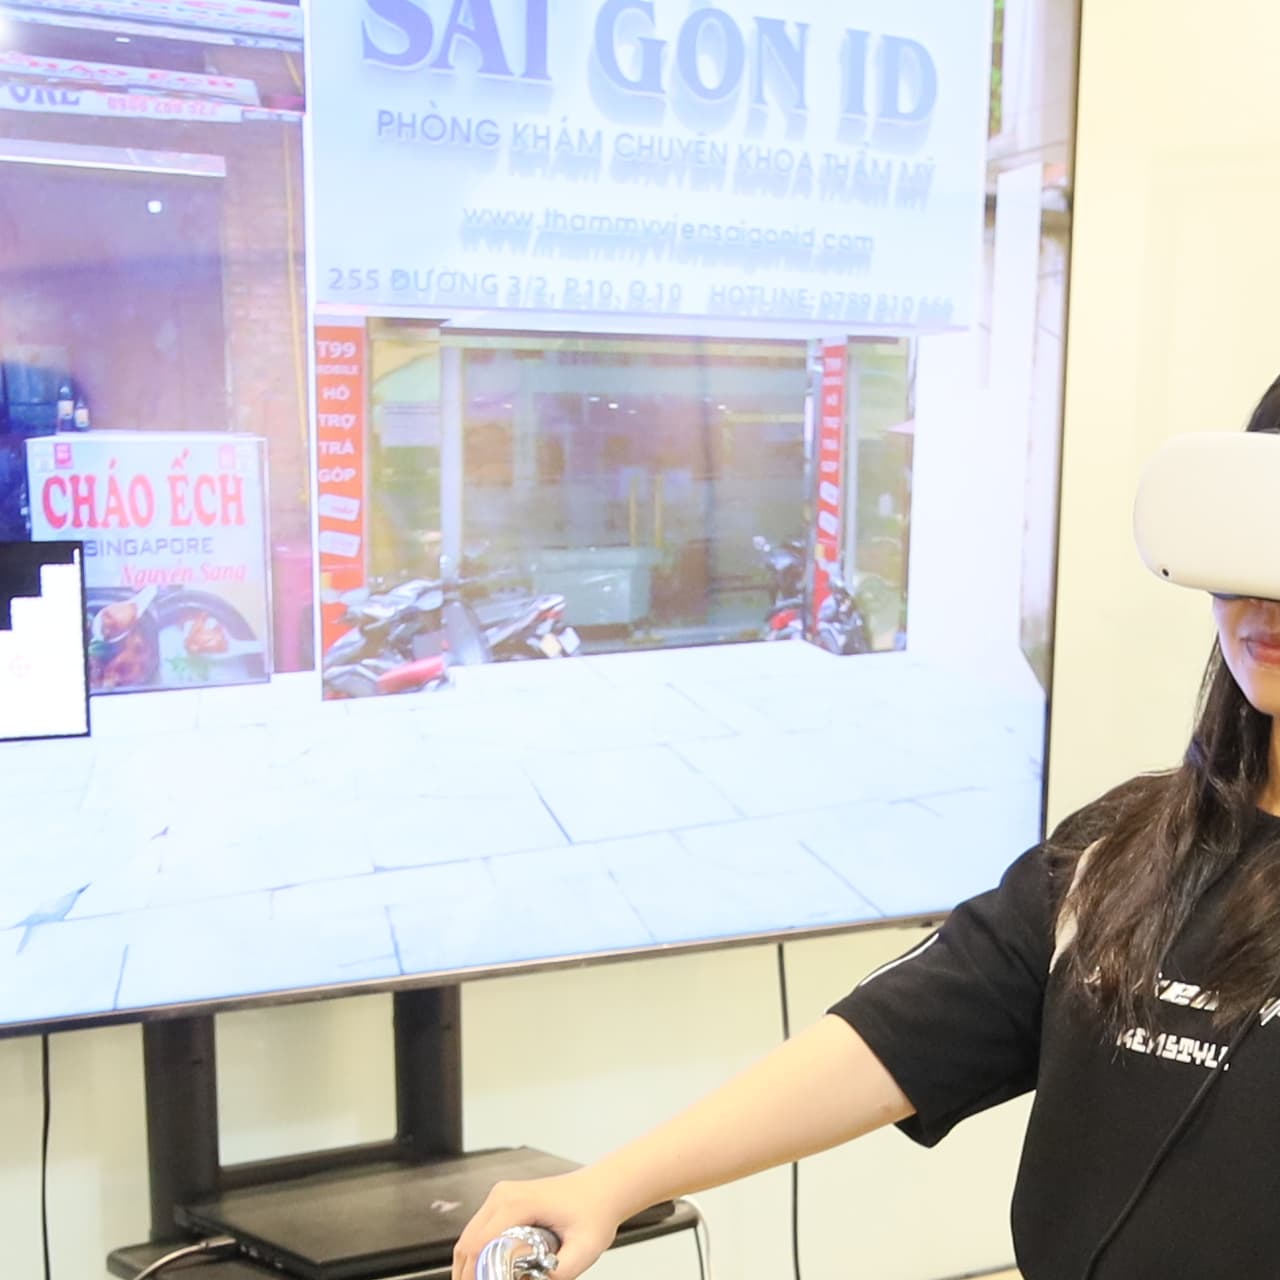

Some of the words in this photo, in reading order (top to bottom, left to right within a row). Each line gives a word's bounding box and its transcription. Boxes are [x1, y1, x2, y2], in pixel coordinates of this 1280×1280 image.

[841, 28, 938, 121] ID
[377, 100, 500, 147] PHÒNG
[512, 116, 602, 153] KHÁM
[737, 144, 813, 176] KHOA
[328, 268, 379, 291] 255
[317, 341, 357, 358] T99
[42, 458, 155, 529] CHÁO
[168, 448, 247, 527] ẾCH
[84, 537, 215, 557] SINGAPORE
